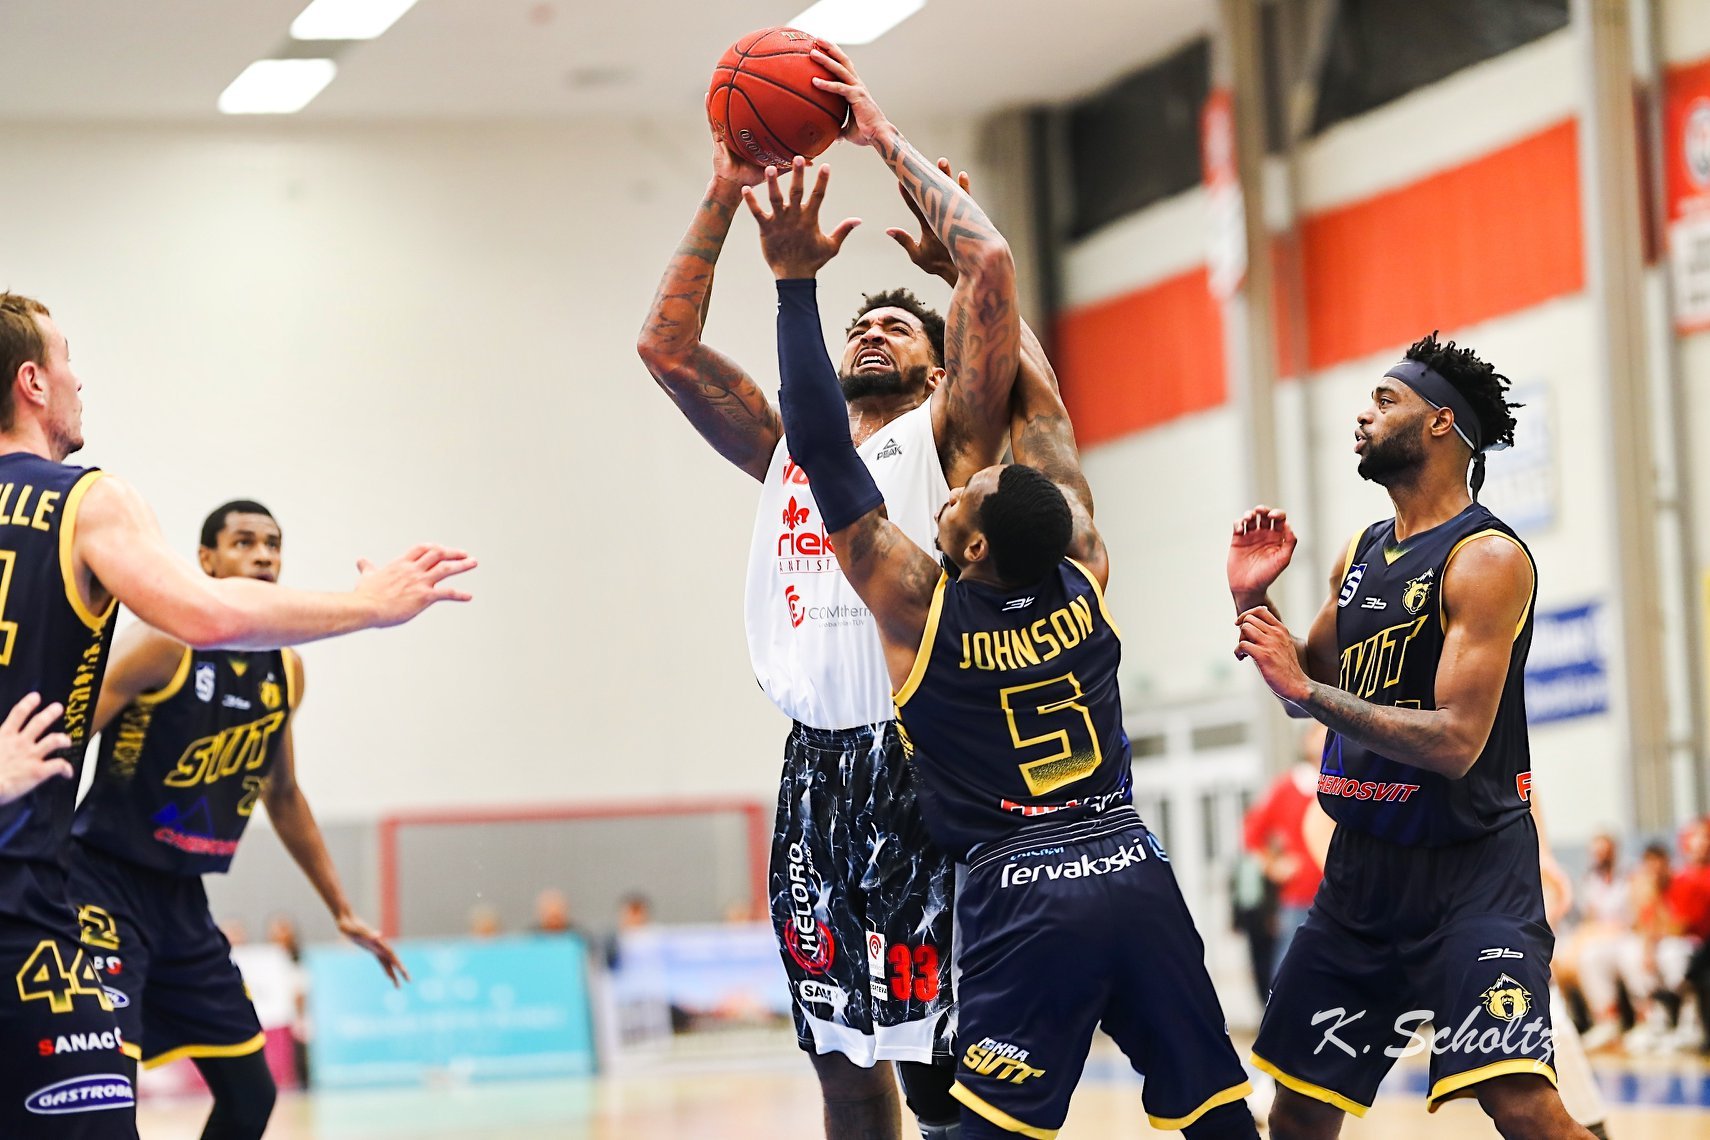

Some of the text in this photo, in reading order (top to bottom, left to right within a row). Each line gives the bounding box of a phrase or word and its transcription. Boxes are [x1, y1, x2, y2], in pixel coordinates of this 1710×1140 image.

[877, 445, 902, 460] PEAK
[0, 482, 61, 532] LLE
[959, 594, 1094, 672] JOHNSON
[1339, 614, 1430, 698] VIT
[162, 710, 286, 788] SVIT
[999, 671, 1103, 797] 5
[788, 842, 820, 960] HELORO
[16, 939, 114, 1013] 44
[888, 943, 940, 1003] 33
[962, 1043, 1046, 1085] SVIT
